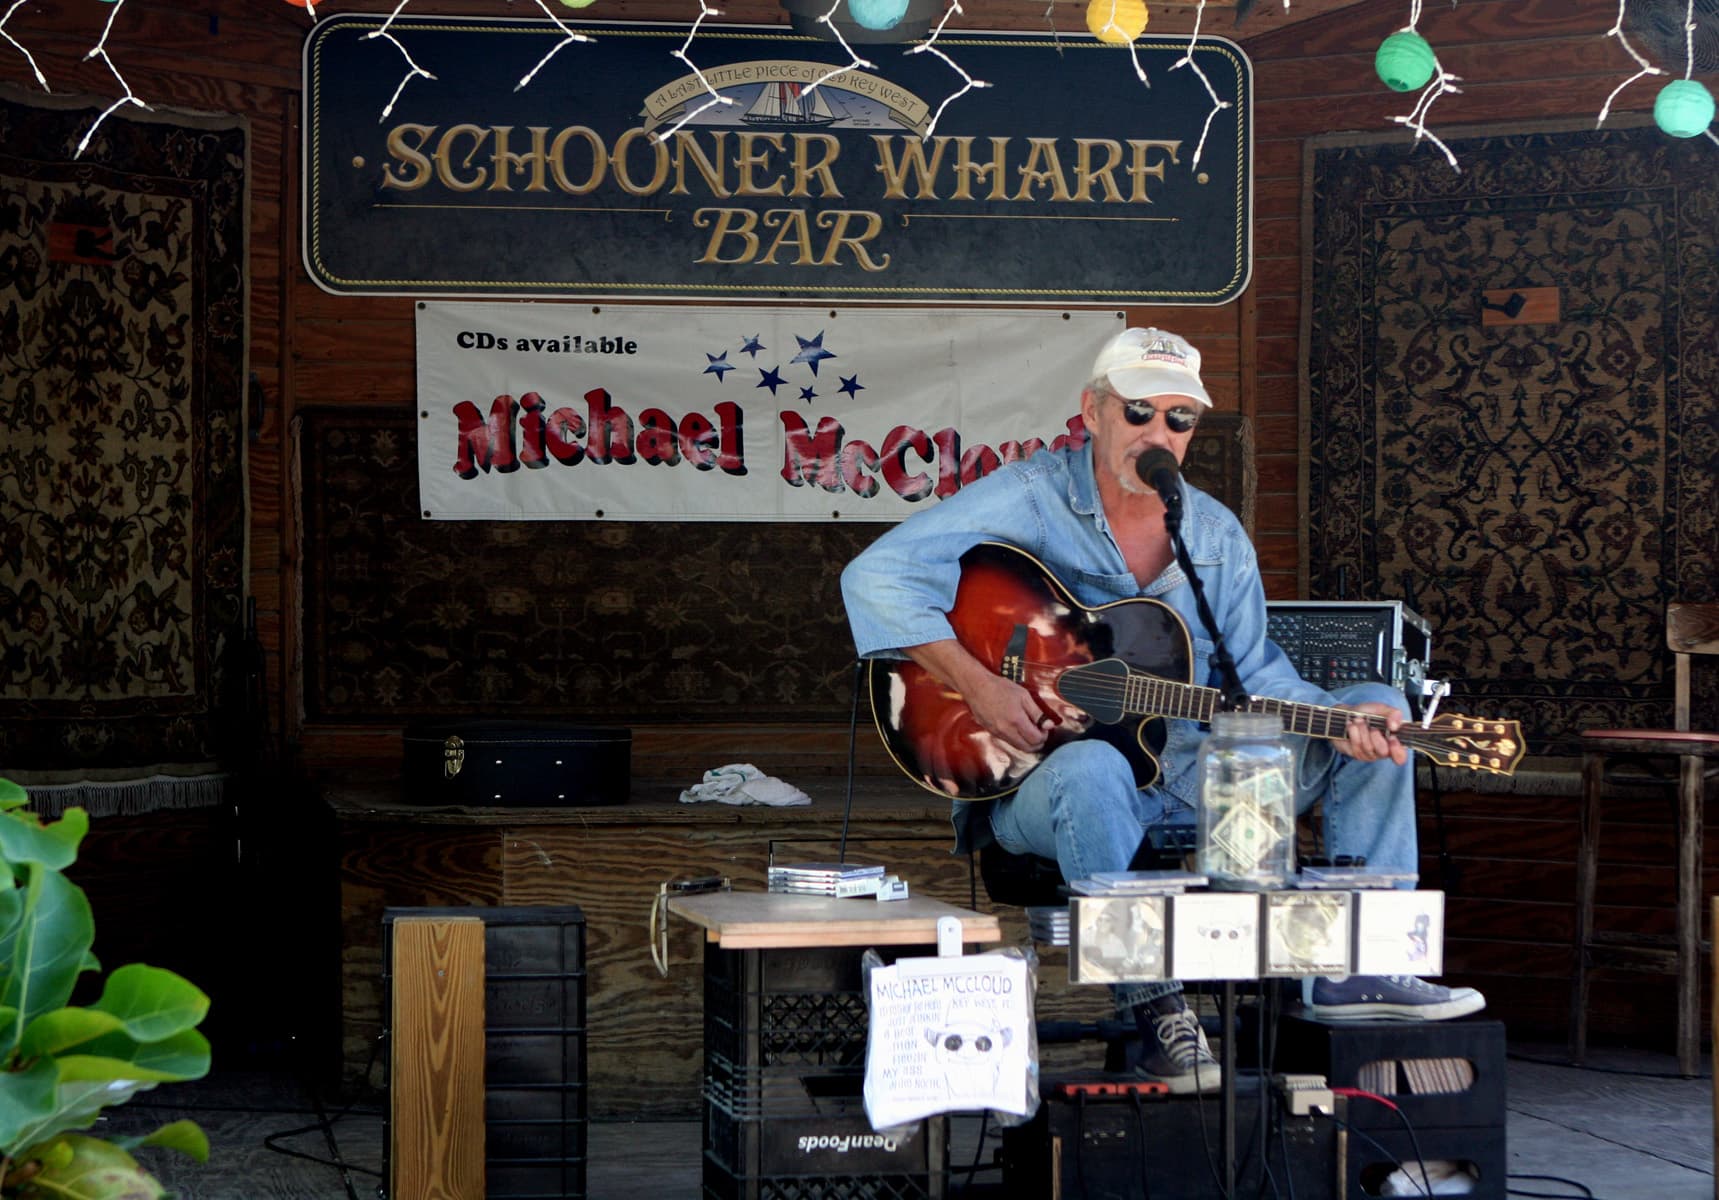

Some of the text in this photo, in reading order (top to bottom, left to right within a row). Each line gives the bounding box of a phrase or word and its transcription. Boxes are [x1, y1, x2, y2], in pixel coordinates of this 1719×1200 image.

[655, 95, 667, 107] A
[667, 78, 702, 99] LAST
[705, 67, 752, 86] LITTLE
[755, 64, 798, 79] PIECE
[381, 122, 1184, 204] SCHOONER WHARF
[692, 207, 890, 272] BAR
[457, 331, 638, 355] CDs available
[453, 388, 748, 480] Michael
[876, 975, 1013, 1000] MICHAEL MCCLOUD
